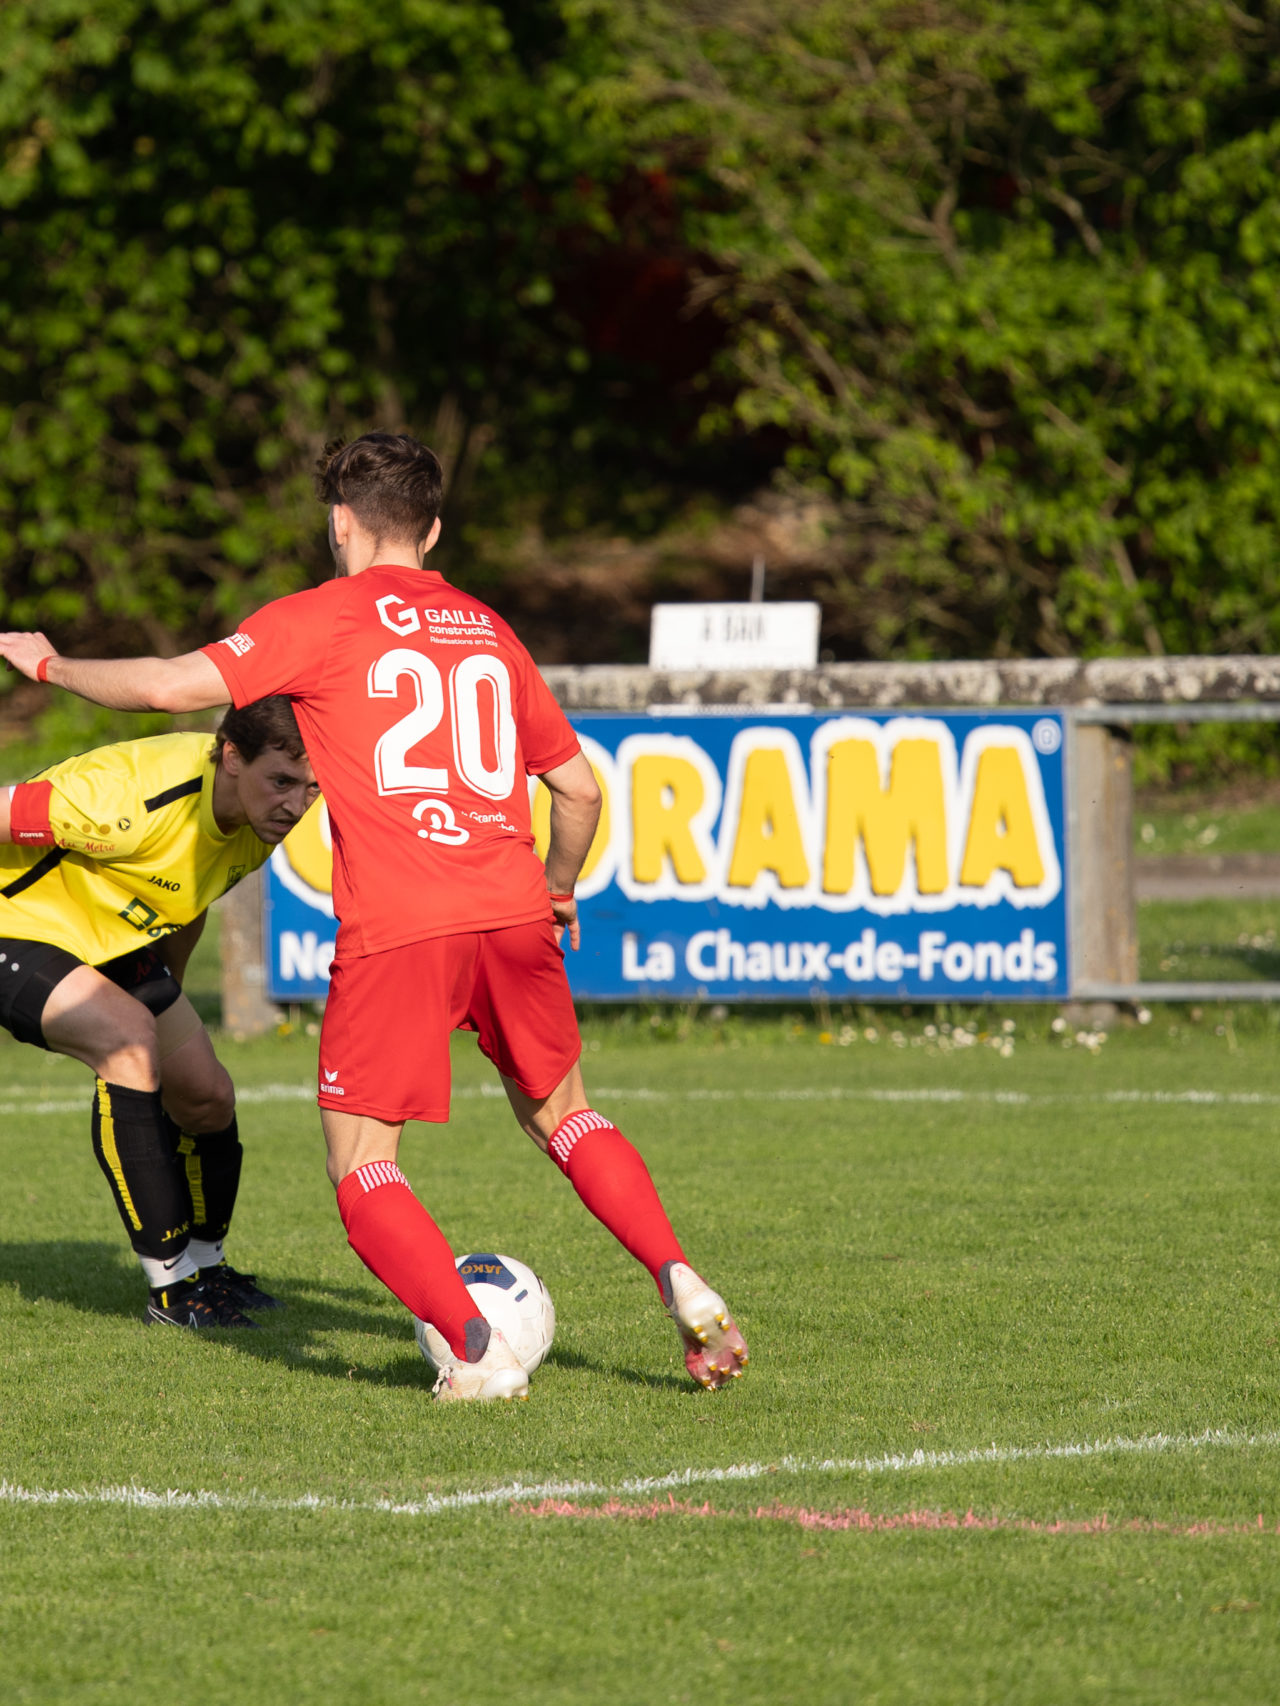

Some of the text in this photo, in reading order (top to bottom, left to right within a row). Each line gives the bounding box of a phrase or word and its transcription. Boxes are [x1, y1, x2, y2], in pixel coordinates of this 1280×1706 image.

[424, 608, 493, 629] GAILLE
[428, 625, 497, 639] construction
[367, 648, 517, 801] 20
[147, 875, 181, 892] JAKO
[622, 931, 674, 981] La
[685, 928, 1057, 981] Chaux-de-Fonds
[161, 1220, 189, 1242] JAK
[461, 1263, 503, 1275] JAKO
